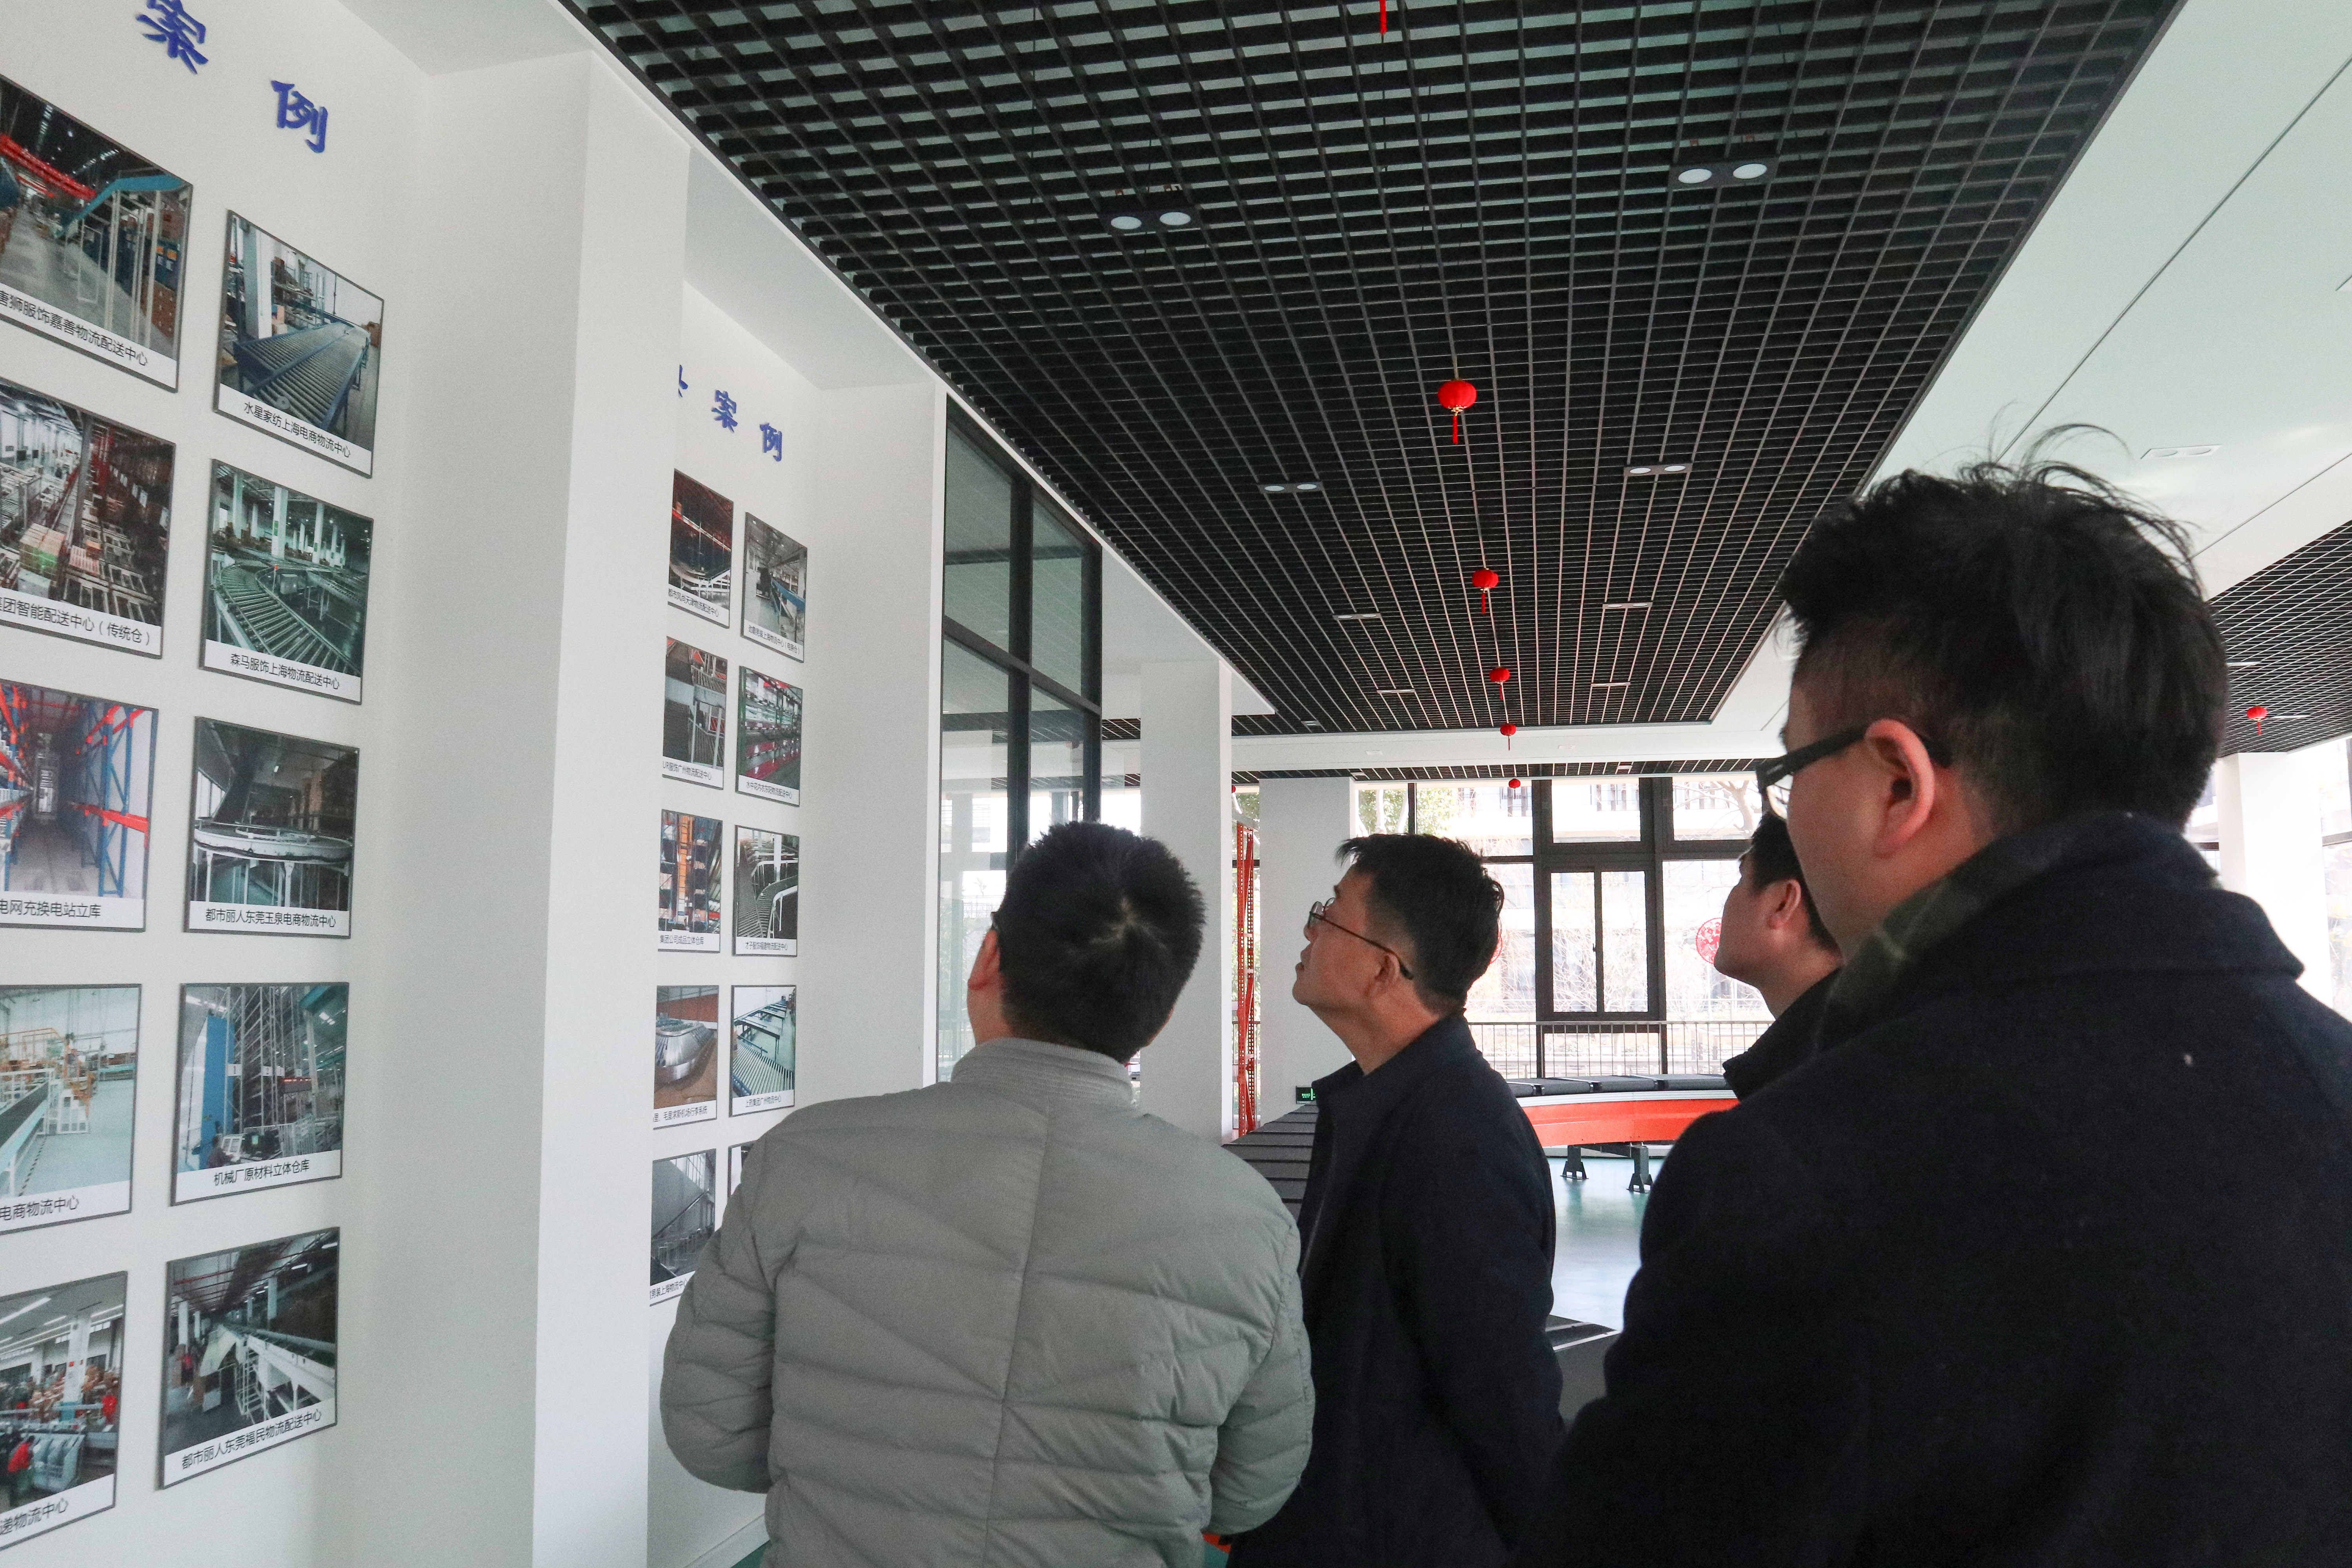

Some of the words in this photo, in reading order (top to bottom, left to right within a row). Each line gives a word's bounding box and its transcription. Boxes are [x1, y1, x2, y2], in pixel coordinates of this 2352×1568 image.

[136, 0, 328, 153] 案例
[0, 290, 148, 366] 唐狮服饰嘉善物流配送中心
[244, 402, 351, 458] 水星家纺上海电商物流中心
[0, 597, 150, 645] 团智能配送中心（传统仓）
[230, 653, 340, 690] 森马服饰上海物流配送中心
[0, 898, 102, 918] 电网充换电站立库
[205, 908, 336, 928] 都市丽人东莞玉泉电商物流中心
[653, 1106, 708, 1122] 里、毛里求斯机场行李系统
[214, 1159, 310, 1187] 机械厂原材料立体仓库
[0, 1195, 80, 1221] 电商物流中心
[650, 1278, 688, 1300] 男装上海物流中心
[181, 1408, 322, 1470] 都市丽人东莞福民物流配送中心
